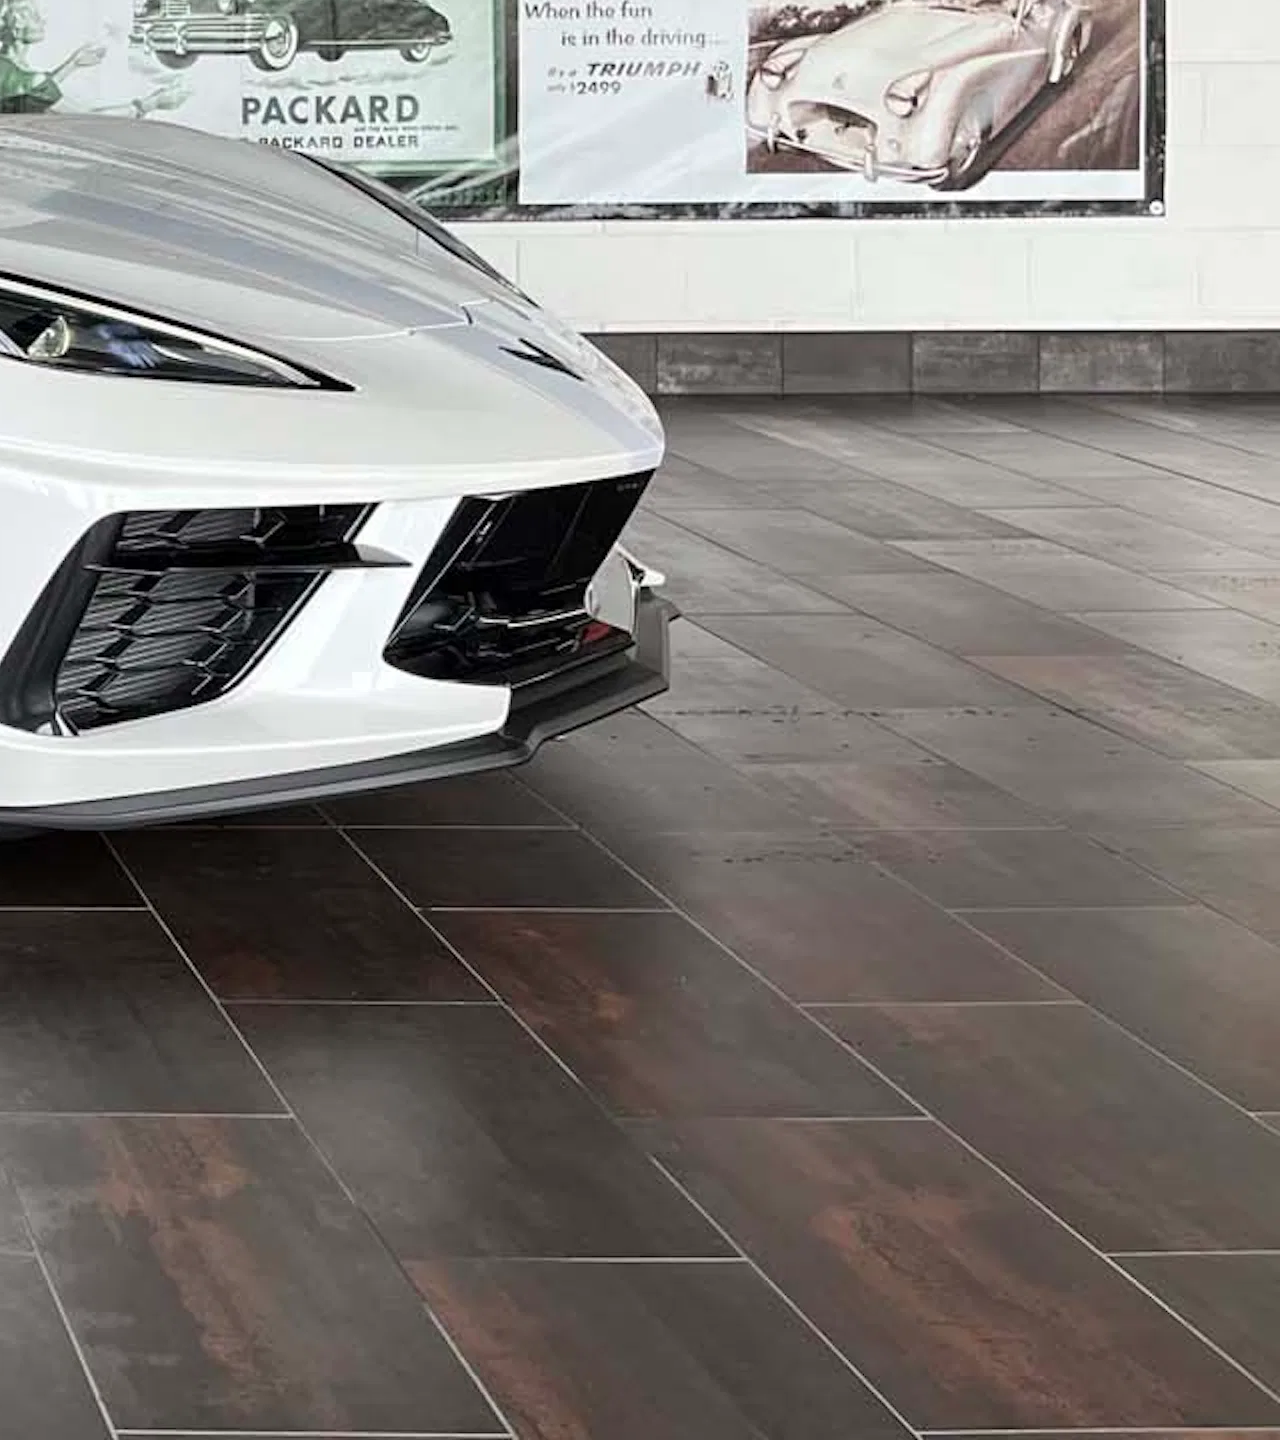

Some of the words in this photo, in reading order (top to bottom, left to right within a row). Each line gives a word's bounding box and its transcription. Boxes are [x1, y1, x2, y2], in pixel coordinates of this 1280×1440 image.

[524, 1, 581, 20] When
[586, 1, 616, 19] the
[621, 0, 653, 19] fun
[560, 30, 577, 47] is
[582, 30, 600, 46] in
[606, 28, 635, 46] the
[587, 61, 702, 77] TRIUMPH
[241, 94, 420, 125] PACKARD
[353, 134, 420, 148] DEALER
